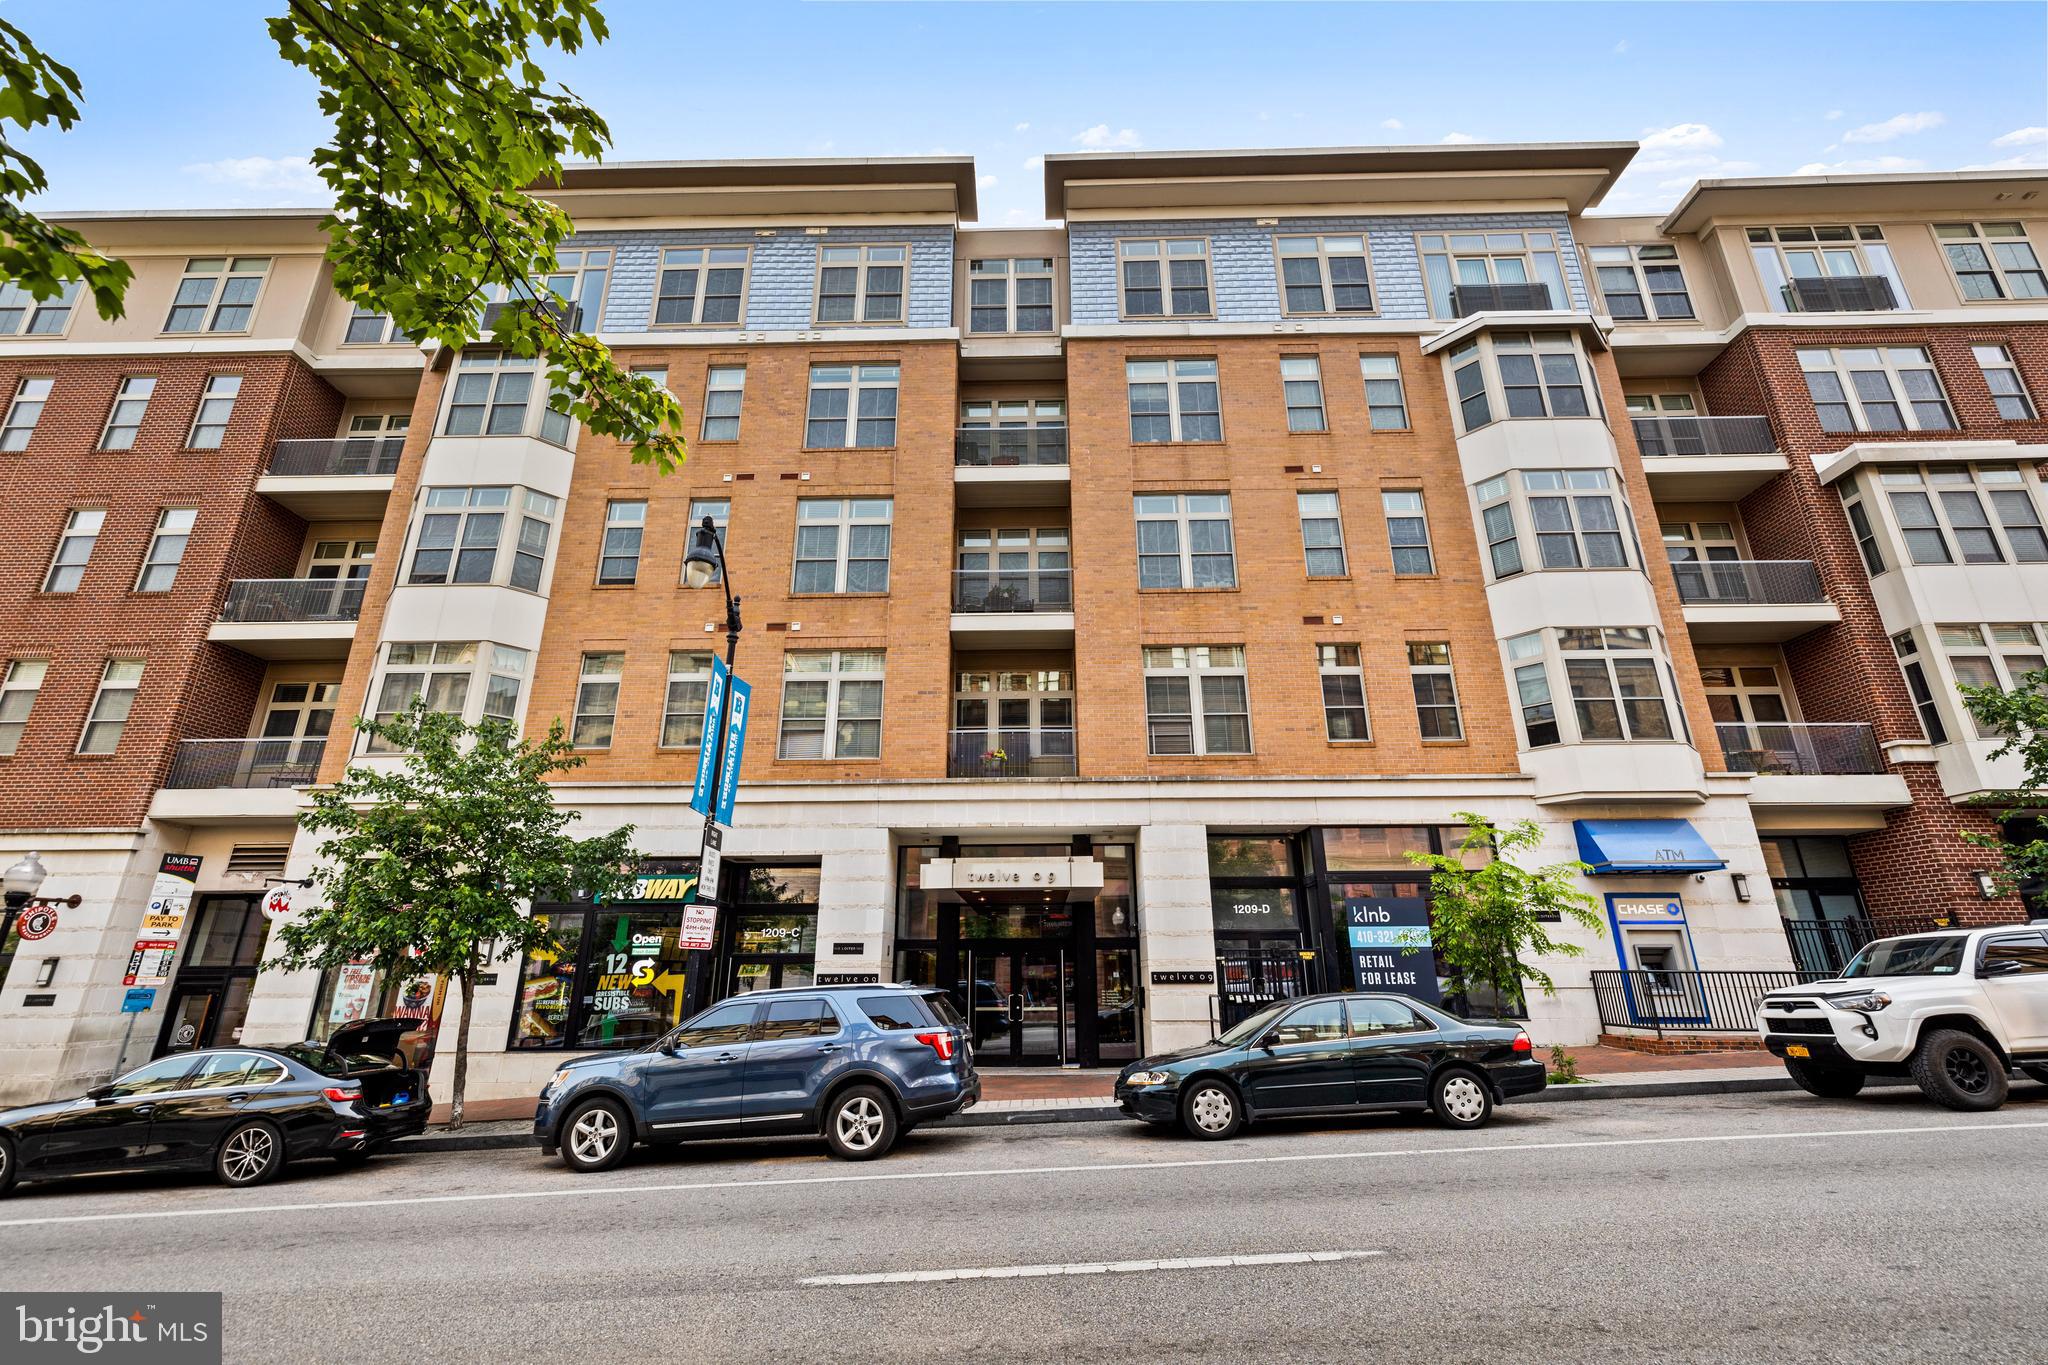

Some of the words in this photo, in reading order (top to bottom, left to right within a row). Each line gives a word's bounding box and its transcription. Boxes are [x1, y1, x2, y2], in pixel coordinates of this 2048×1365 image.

[166, 856, 188, 864] UMB
[1656, 849, 1684, 860] ATM
[968, 870, 1020, 882] twelve
[24, 906, 58, 921] CHIPOTLE
[1232, 904, 1270, 914] 1209-D
[1353, 906, 1390, 922] klnb
[1618, 904, 1666, 914] CHASE
[761, 928, 800, 937] 1209-C
[632, 934, 662, 946] Open
[606, 953, 628, 974] 12
[1360, 956, 1394, 968] RETAIL
[597, 975, 633, 990] NEW
[818, 974, 858, 982] twelve
[1361, 972, 1381, 984] FOR
[1385, 972, 1416, 984] LEASE
[594, 996, 630, 1011] SUBS
[392, 1005, 430, 1019] WANNA
